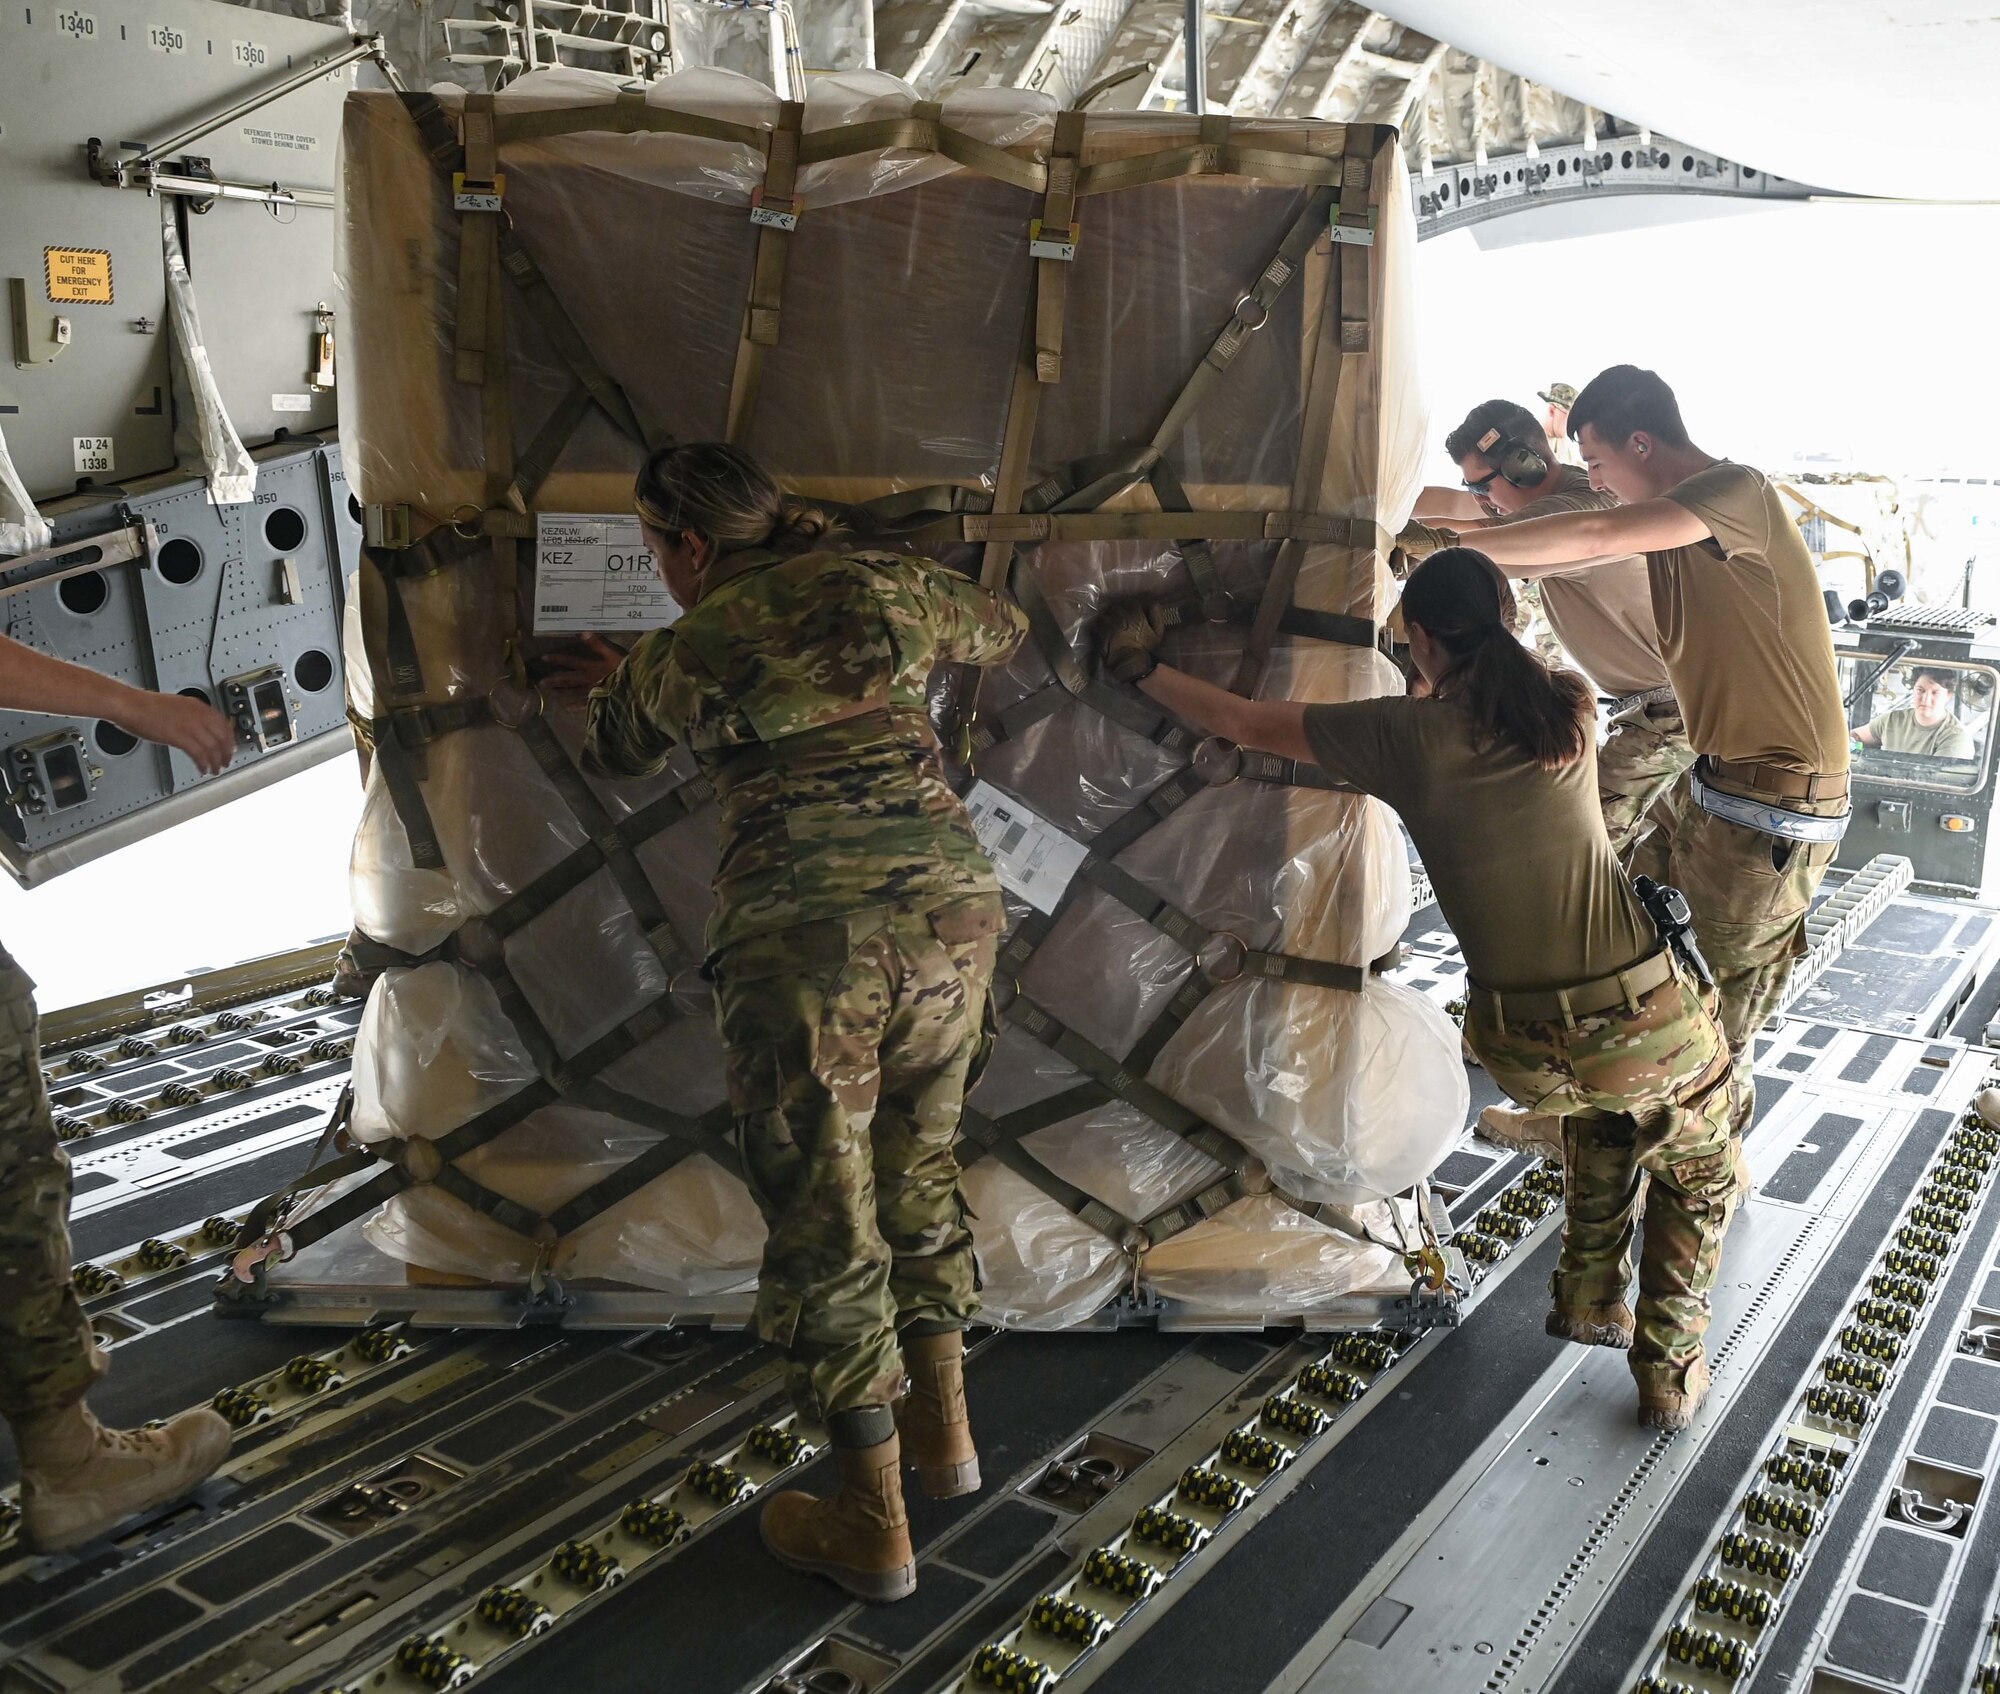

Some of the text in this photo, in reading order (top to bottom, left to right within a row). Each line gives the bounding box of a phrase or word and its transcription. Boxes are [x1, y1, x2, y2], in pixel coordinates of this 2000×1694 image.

[59, 14, 94, 35] 1340
[151, 30, 183, 49] 1350
[235, 45, 265, 64] 1360
[243, 128, 316, 144] DEFENSIVE SYSTEM COVERS
[251, 137, 310, 151] STOWED BEHIND LINER
[1334, 230, 1342, 240] A
[59, 255, 97, 265] CUT HERE
[71, 266, 86, 275] FOR
[56, 276, 102, 286] EMERGENCY
[72, 287, 88, 296] EXIT
[78, 439, 109, 450] AD 24
[81, 458, 108, 471] 1338
[254, 492, 278, 505] 1350
[541, 551, 574, 565] KEZ
[607, 554, 652, 571] O1R
[627, 584, 647, 592] 1700
[626, 610, 642, 618] 424
